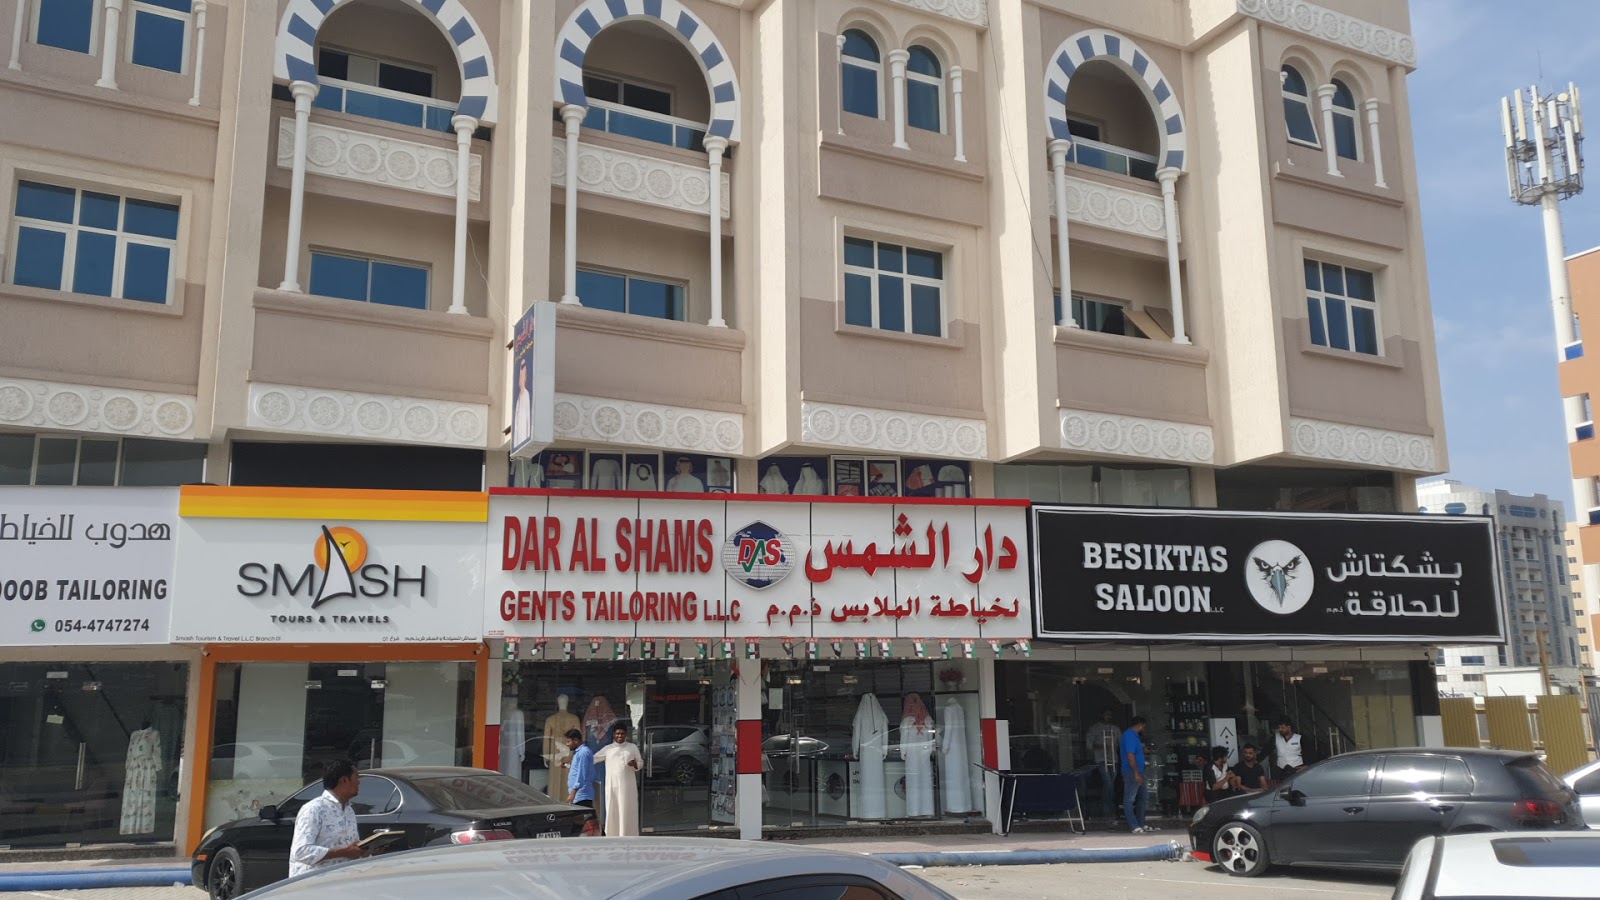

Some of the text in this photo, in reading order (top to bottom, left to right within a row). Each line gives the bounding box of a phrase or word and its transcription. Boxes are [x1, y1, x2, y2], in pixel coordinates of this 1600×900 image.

[0, 513, 171, 549] هدوب للخياط
[502, 516, 713, 573] DAR AL SHAMS
[737, 538, 781, 572] DAS
[804, 512, 1018, 584] دار الشمس
[1082, 541, 1229, 573] BESIKTAS
[1326, 547, 1463, 586] بشكتاش
[0, 579, 167, 601] OOB TAILORING
[1095, 583, 1211, 613] SALOON
[1345, 590, 1460, 618] للحلاقة
[270, 615, 312, 624] TOURS
[332, 615, 390, 624] TRAVELS
[500, 590, 741, 622] GENTS TAILORING L.L.C
[830, 595, 921, 624] الملابس
[930, 595, 1020, 625] لخياطة
[54, 618, 150, 632] 054-4747274
